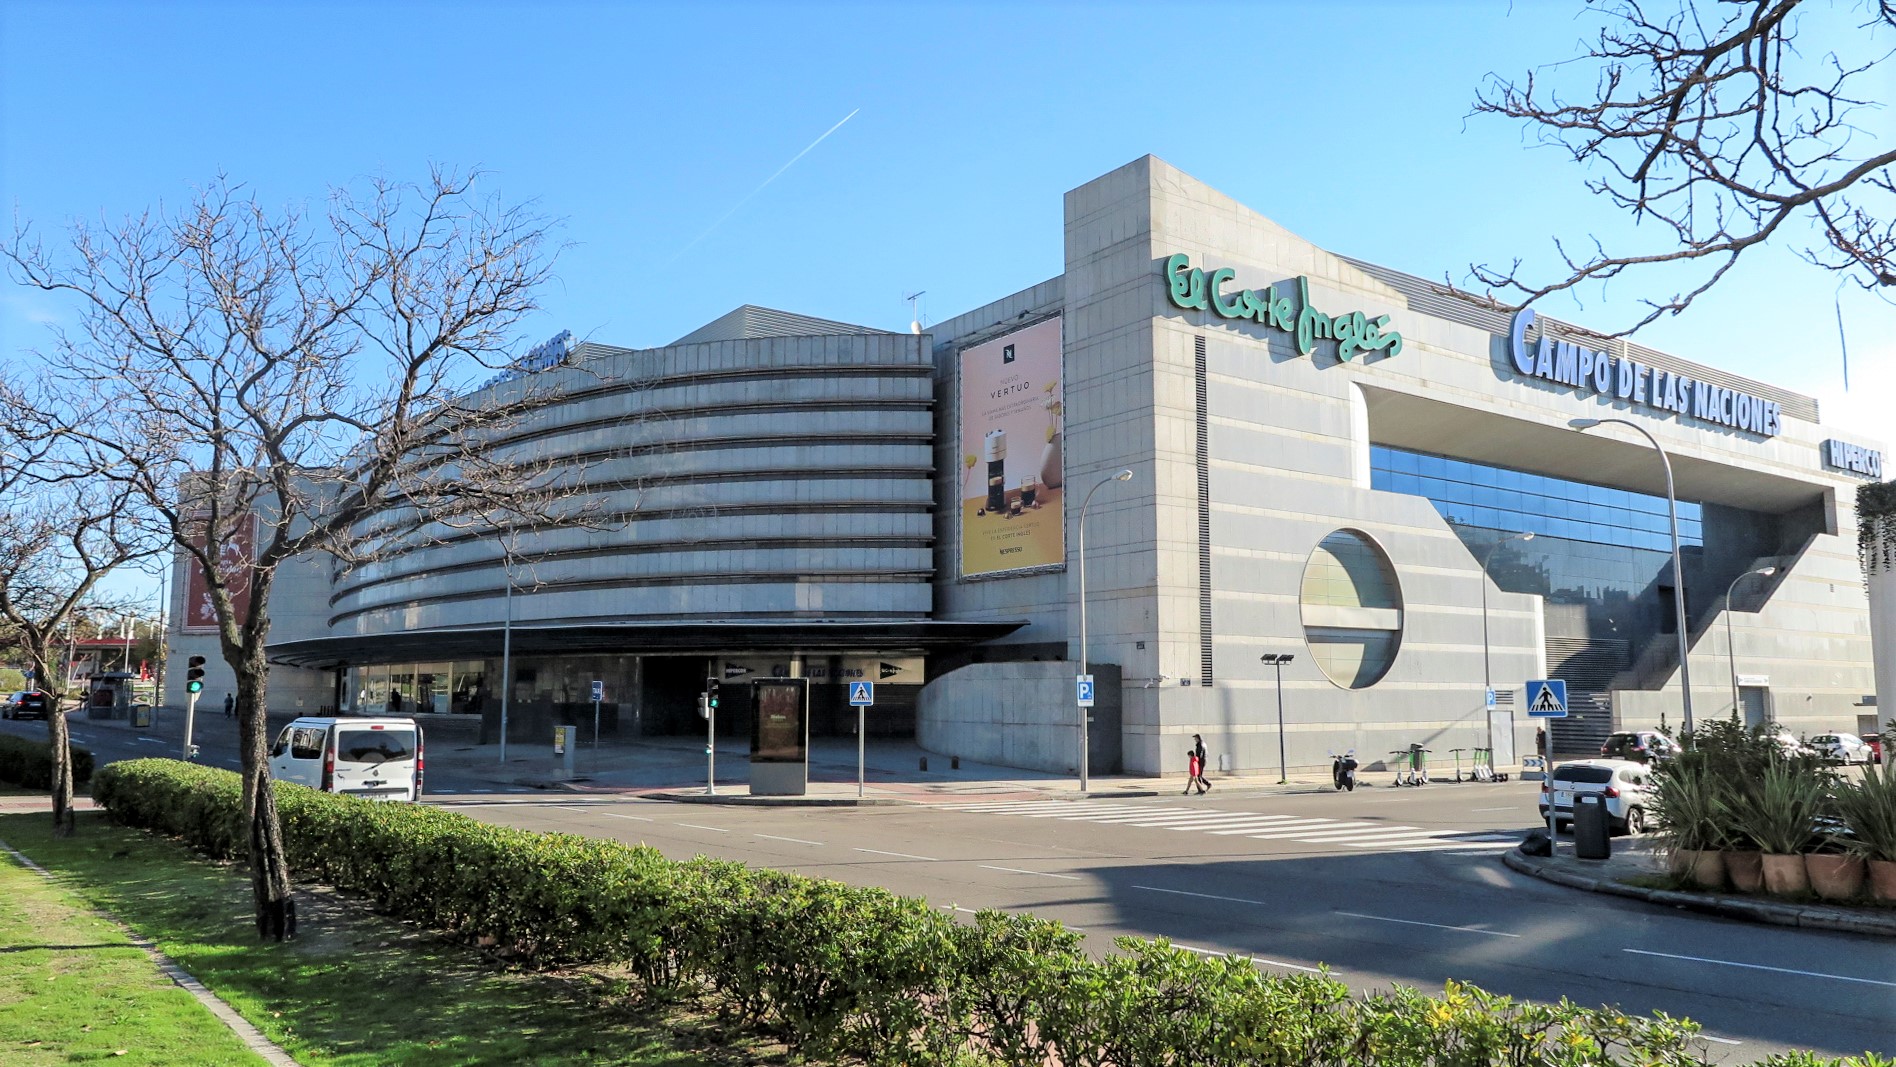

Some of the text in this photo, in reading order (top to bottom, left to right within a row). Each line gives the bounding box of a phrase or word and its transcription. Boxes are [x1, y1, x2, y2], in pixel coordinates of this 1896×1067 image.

[1164, 253, 1403, 362] El Corte Inglés
[1000, 374, 1019, 385] NUEVO
[1509, 308, 1782, 437] CAMPO DE LAS NACIONES
[990, 381, 1030, 399] VERTUO
[1079, 683, 1090, 699] P
